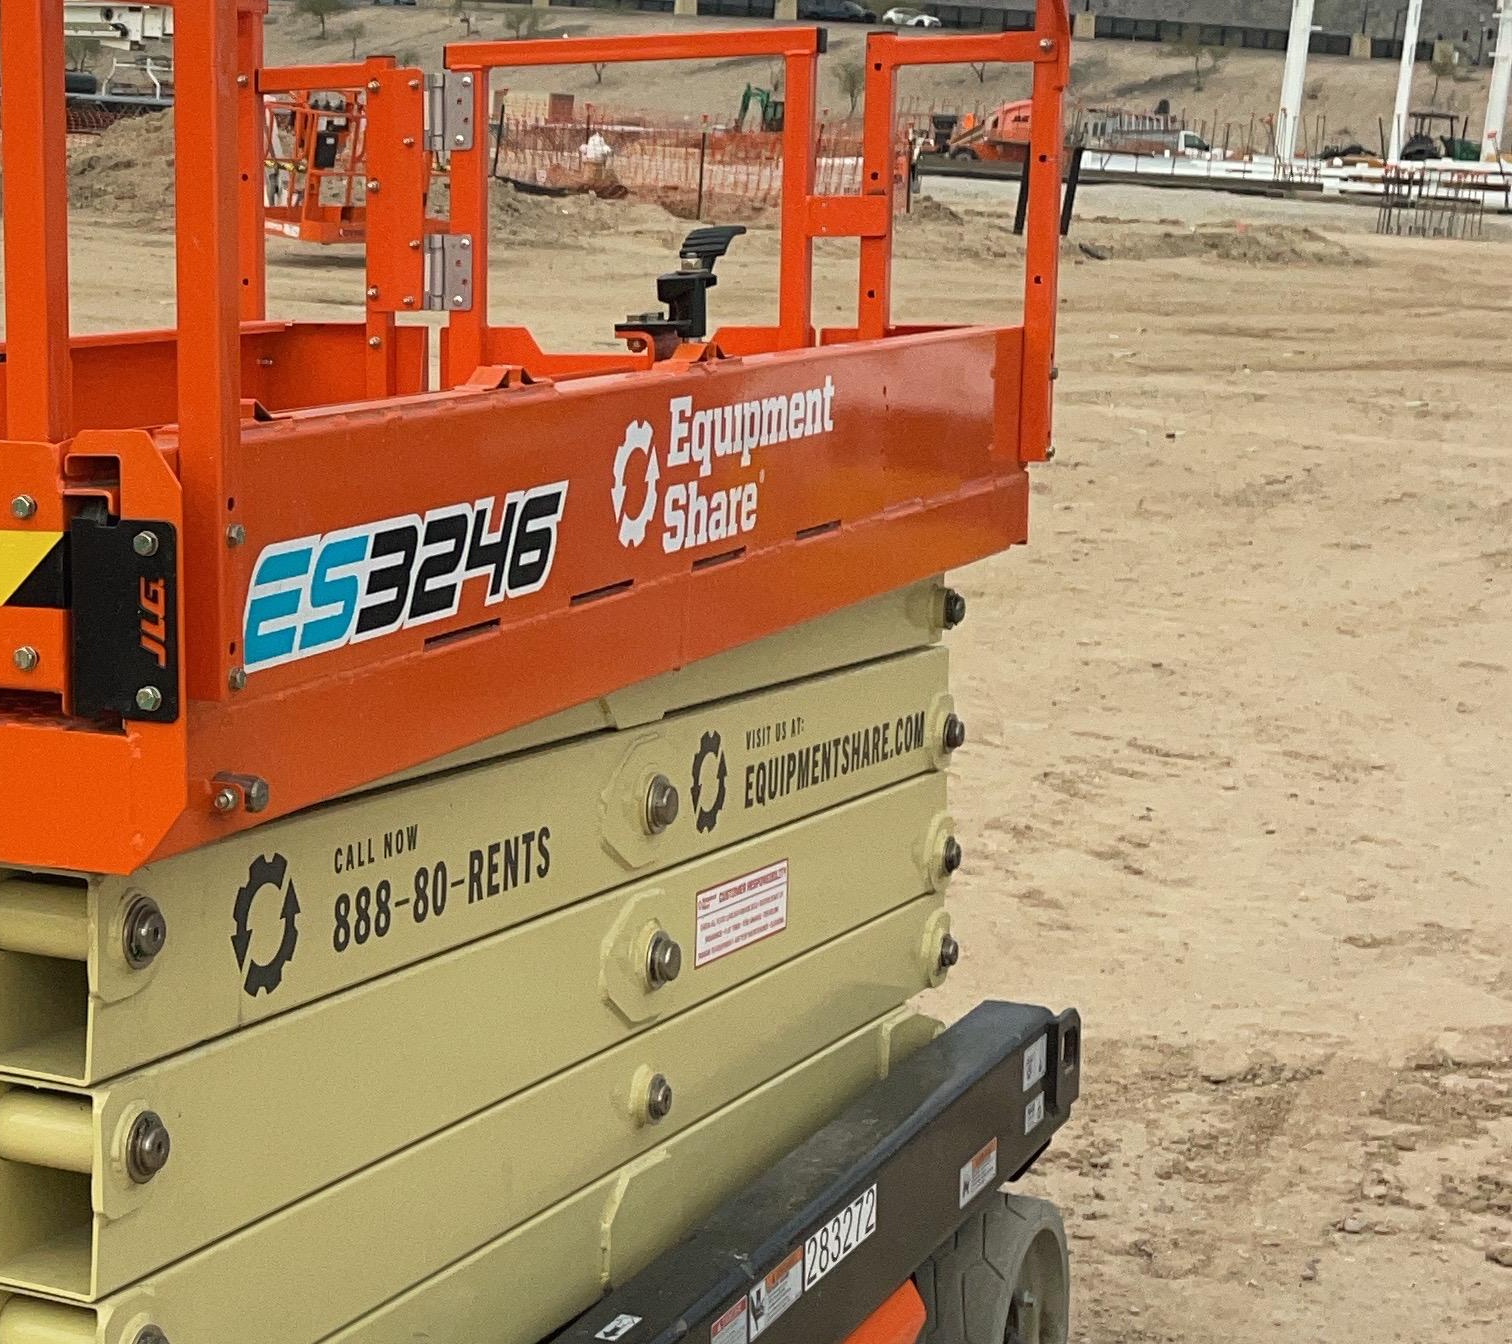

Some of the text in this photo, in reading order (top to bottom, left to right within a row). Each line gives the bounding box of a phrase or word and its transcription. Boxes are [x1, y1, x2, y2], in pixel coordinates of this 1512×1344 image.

[667, 375, 835, 478] Equipment
[662, 481, 758, 554] Share
[140, 576, 166, 669] JLG
[242, 481, 570, 674] ES3246
[744, 710, 925, 809] EQUIPMENTSHARE.COM
[745, 716, 805, 750] VISIT US AT:
[333, 826, 550, 952] 888-80-RENTS
[334, 824, 418, 874] CALL NOW
[807, 1187, 875, 1286] 283272
